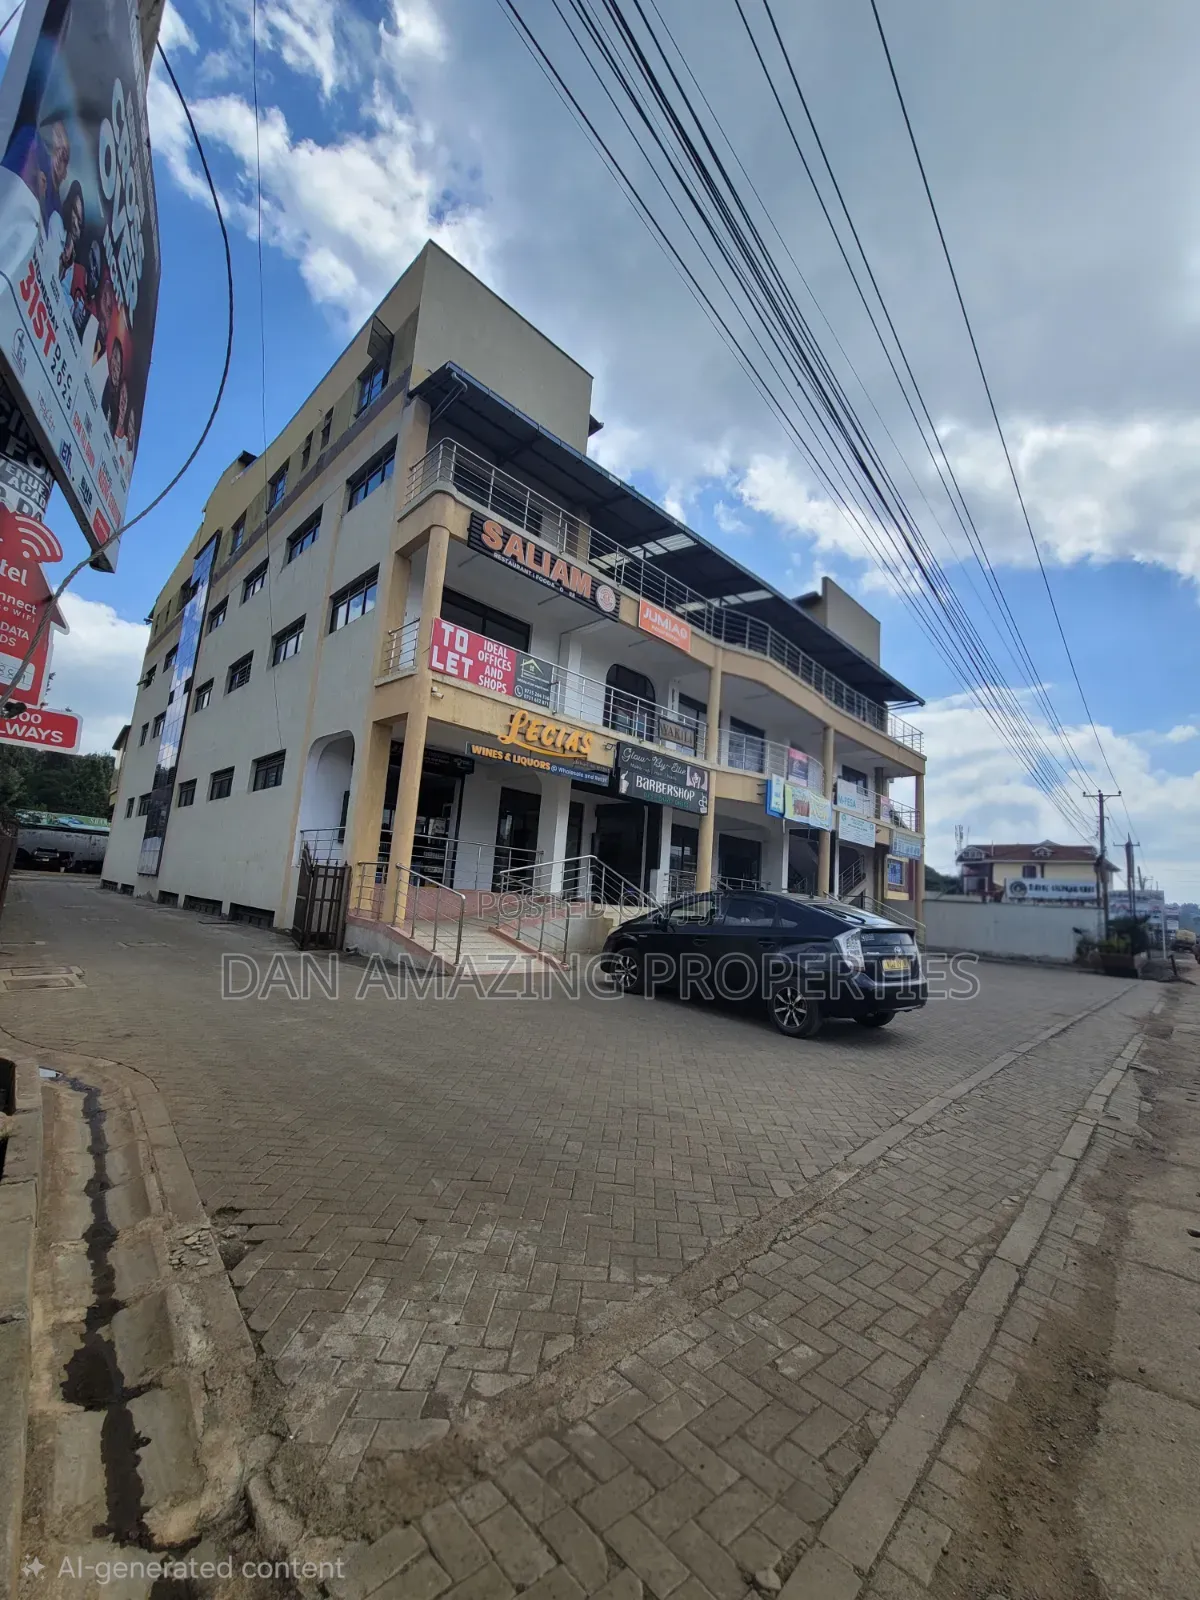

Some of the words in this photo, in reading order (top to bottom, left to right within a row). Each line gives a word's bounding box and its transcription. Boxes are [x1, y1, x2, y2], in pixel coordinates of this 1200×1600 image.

[112, 77, 145, 281] CROSS
[99, 117, 138, 329] OVER
[20, 259, 57, 358] 31ST
[54, 343, 73, 390] DEC
[50, 357, 73, 411] 2025
[481, 519, 592, 599] SALIAM
[493, 552, 532, 576] RESTAURANT
[1, 621, 30, 641] DATA
[441, 622, 469, 655] TO
[431, 645, 474, 679] LET
[477, 650, 512, 672] OFFICES
[483, 640, 508, 660] IDEAL
[478, 674, 507, 694] SHOPS
[484, 664, 503, 681] AND
[498, 709, 594, 757] LECIAS
[471, 744, 503, 760] WINES
[503, 752, 511, 762] &
[513, 754, 551, 771] LIQUORS
[558, 767, 584, 778] Wholesale
